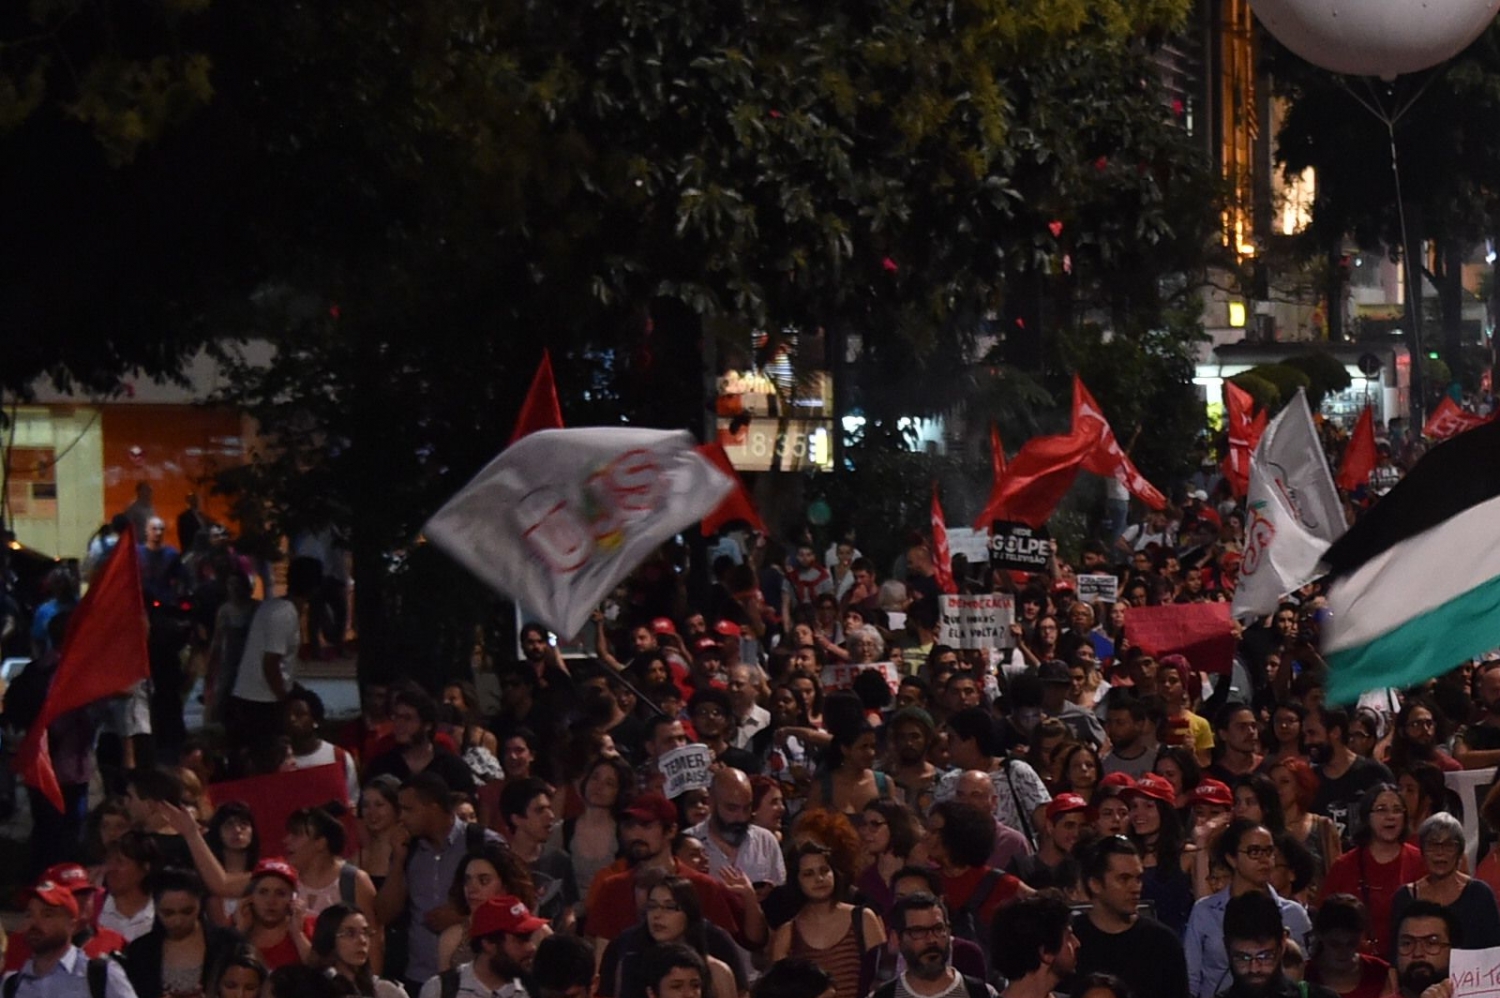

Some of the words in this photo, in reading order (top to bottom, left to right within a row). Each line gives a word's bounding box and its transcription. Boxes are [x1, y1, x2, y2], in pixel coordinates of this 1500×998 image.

[992, 535, 1050, 556] GOLPE
[948, 628, 965, 638] ELA
[970, 626, 1005, 639] VOLTA?
[664, 753, 706, 776] TEMER
